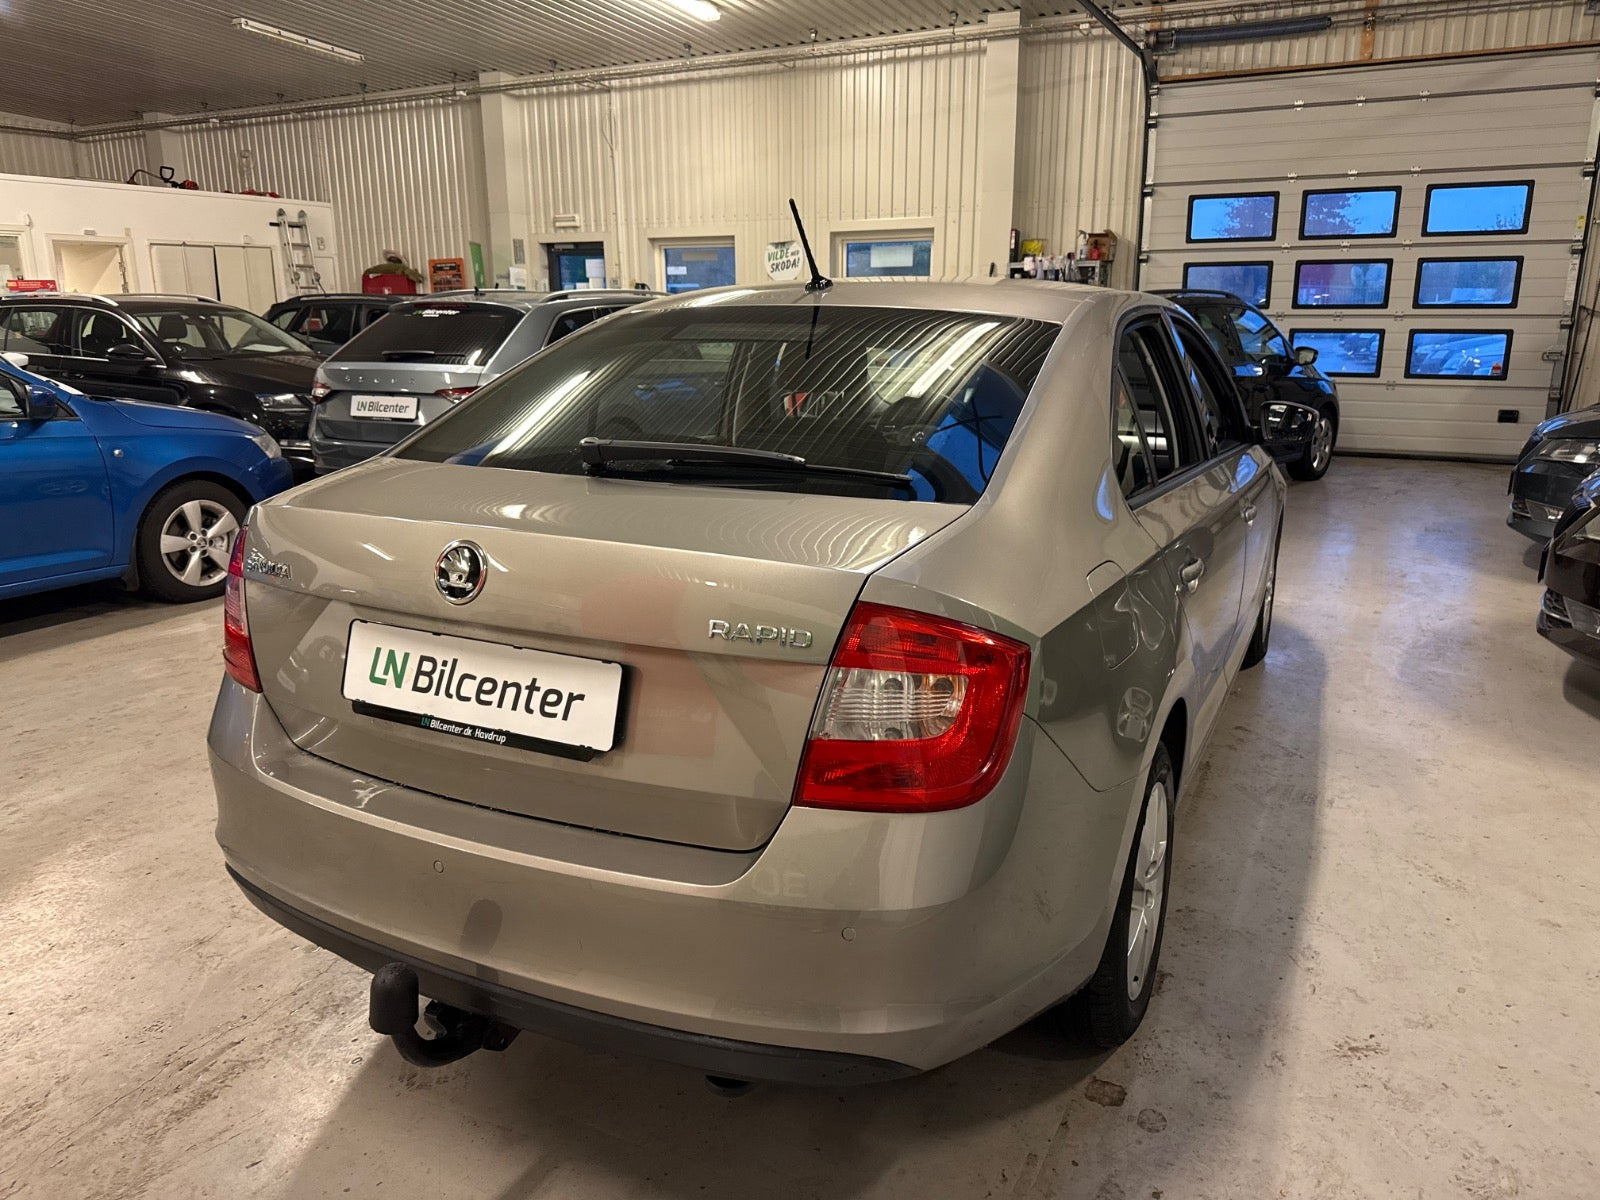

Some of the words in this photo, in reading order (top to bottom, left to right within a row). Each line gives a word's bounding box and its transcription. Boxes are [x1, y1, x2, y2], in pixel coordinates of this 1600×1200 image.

[768, 248, 789, 262] VILDE
[770, 257, 800, 273] SKODA!
[367, 401, 410, 413] Bilcenter
[708, 619, 813, 648] RAPID
[369, 646, 410, 689] LN
[411, 654, 585, 721] Bilcenter
[474, 727, 506, 744] Havdrup
